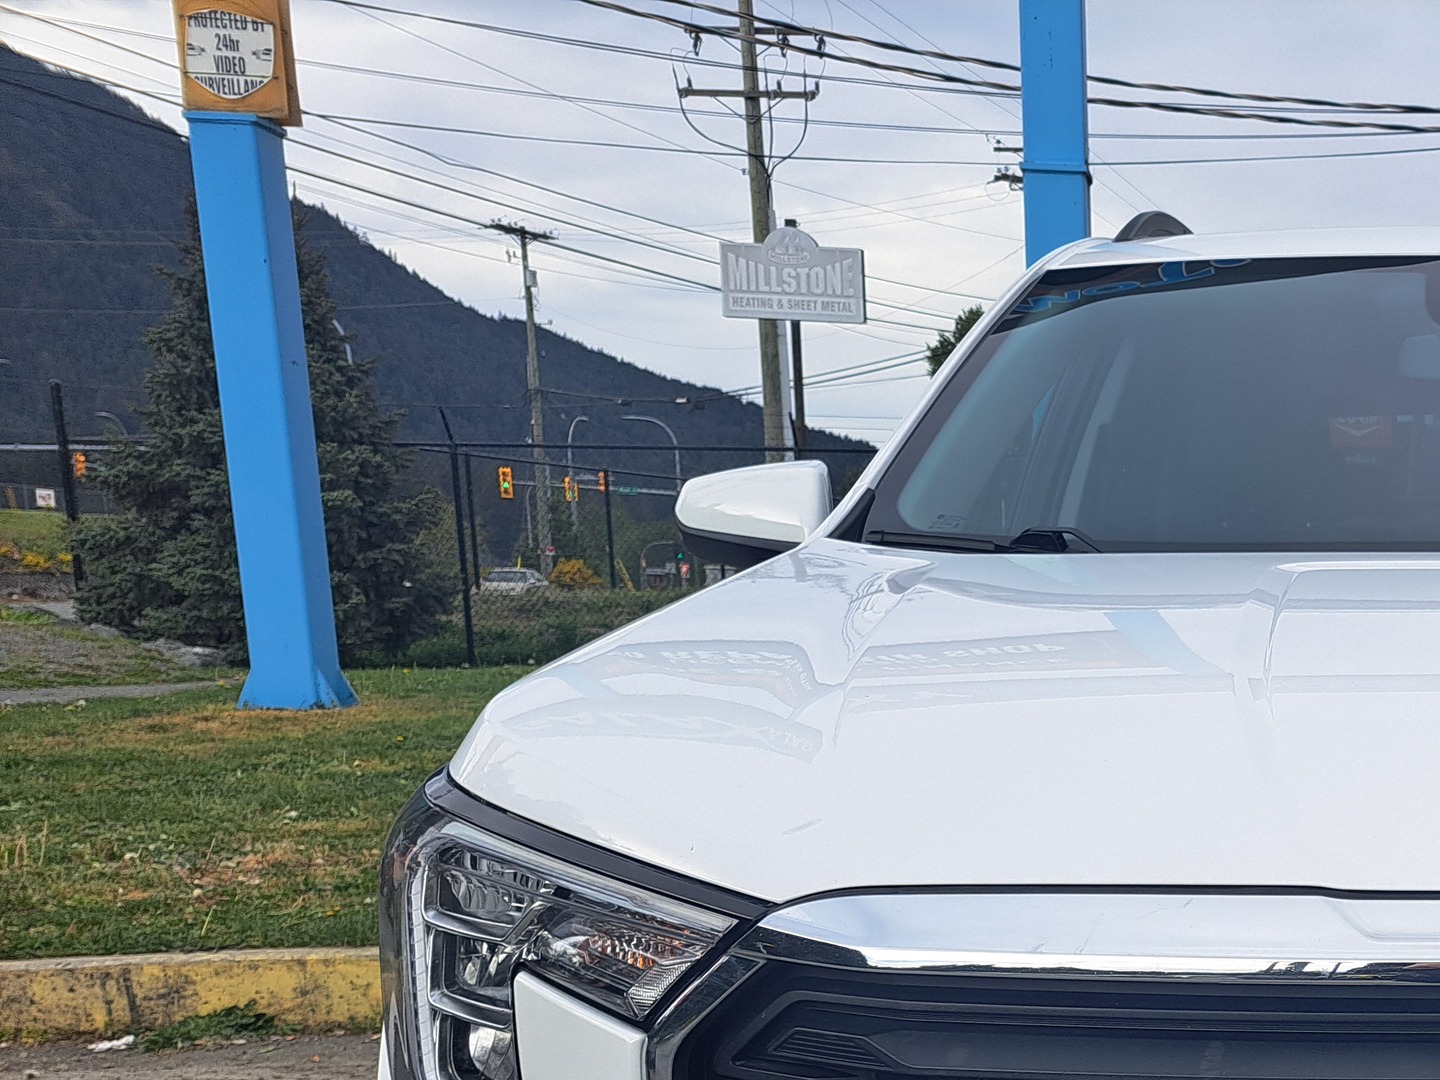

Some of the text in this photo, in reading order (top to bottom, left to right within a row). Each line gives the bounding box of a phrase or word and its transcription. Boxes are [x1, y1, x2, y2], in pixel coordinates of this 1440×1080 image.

[214, 33, 240, 52] 24hr
[213, 55, 246, 75] VIDEO
[727, 252, 854, 296] MILLSTONE
[731, 296, 853, 314] HEATING & SHEET METAL
